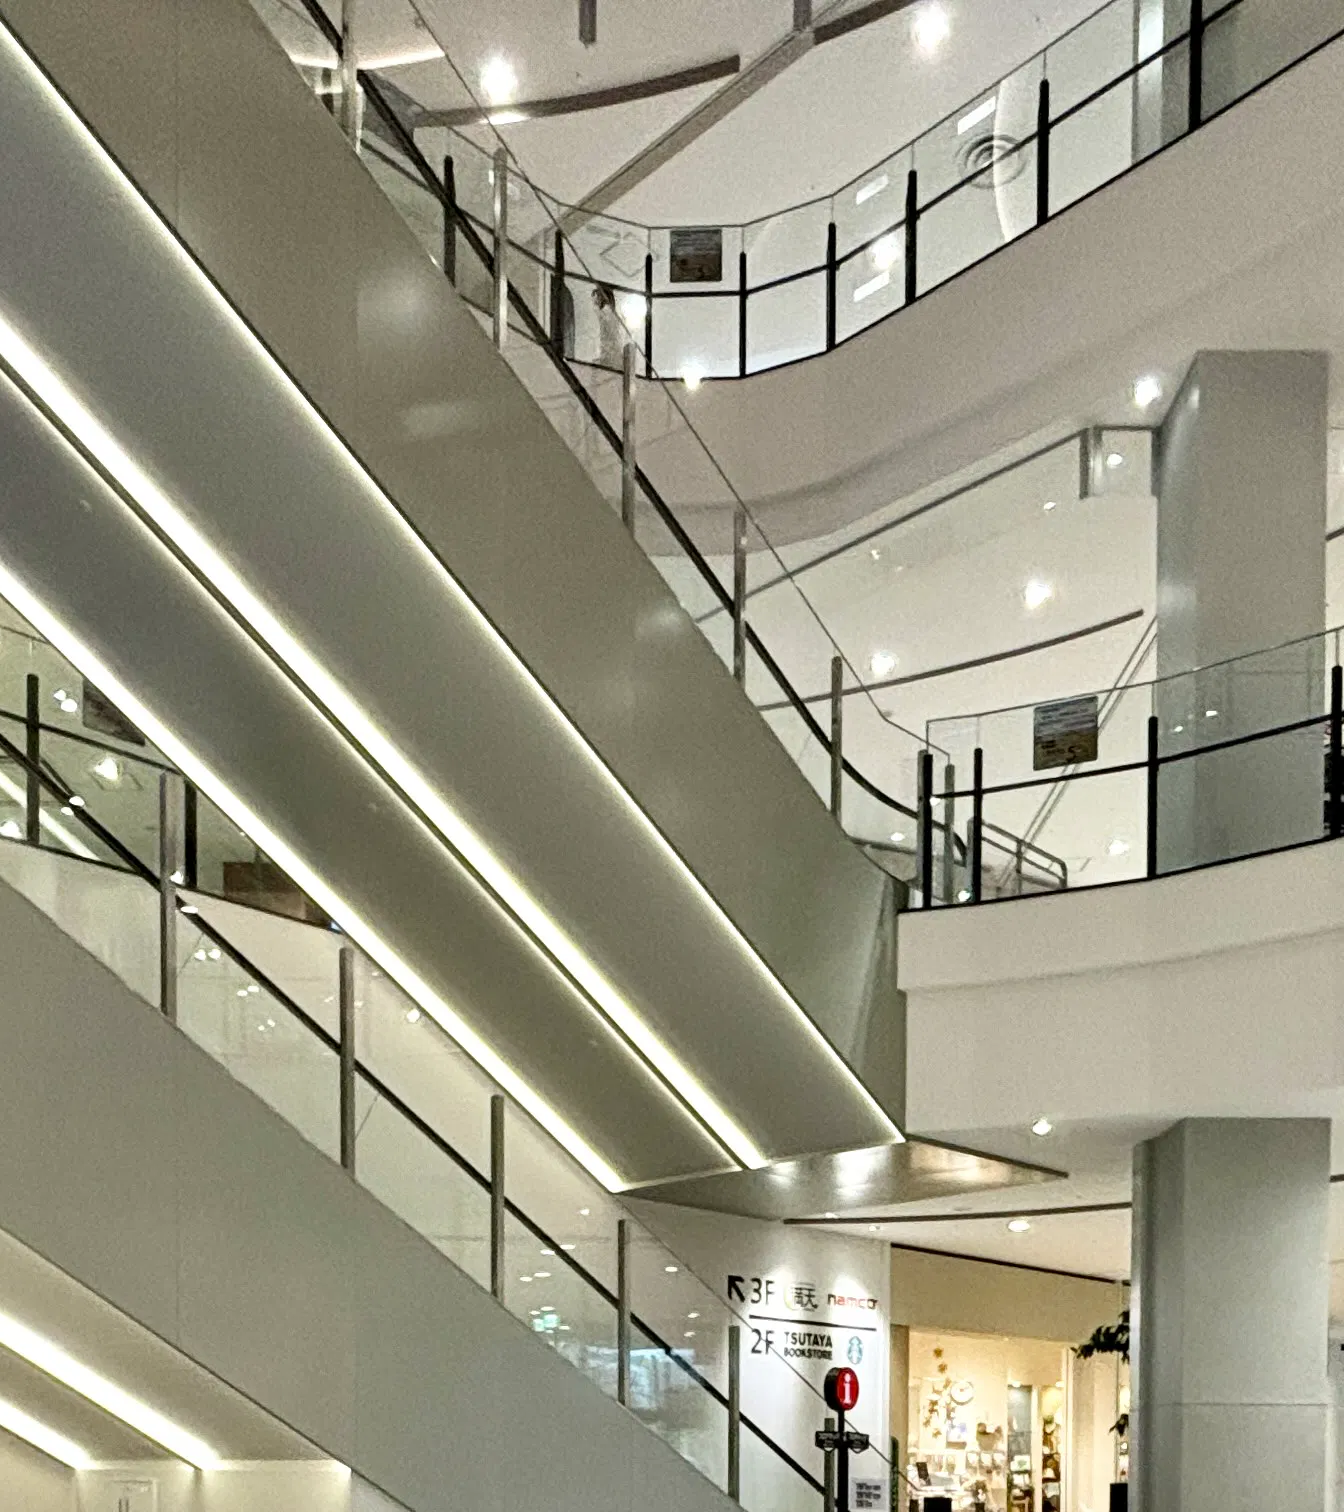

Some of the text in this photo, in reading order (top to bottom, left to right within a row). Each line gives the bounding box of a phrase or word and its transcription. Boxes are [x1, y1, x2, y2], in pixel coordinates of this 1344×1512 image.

[750, 1277, 775, 1305] 3F
[750, 1328, 833, 1355] 2F TSUTAYA
[783, 1347, 833, 1361] BOOKSTORE
